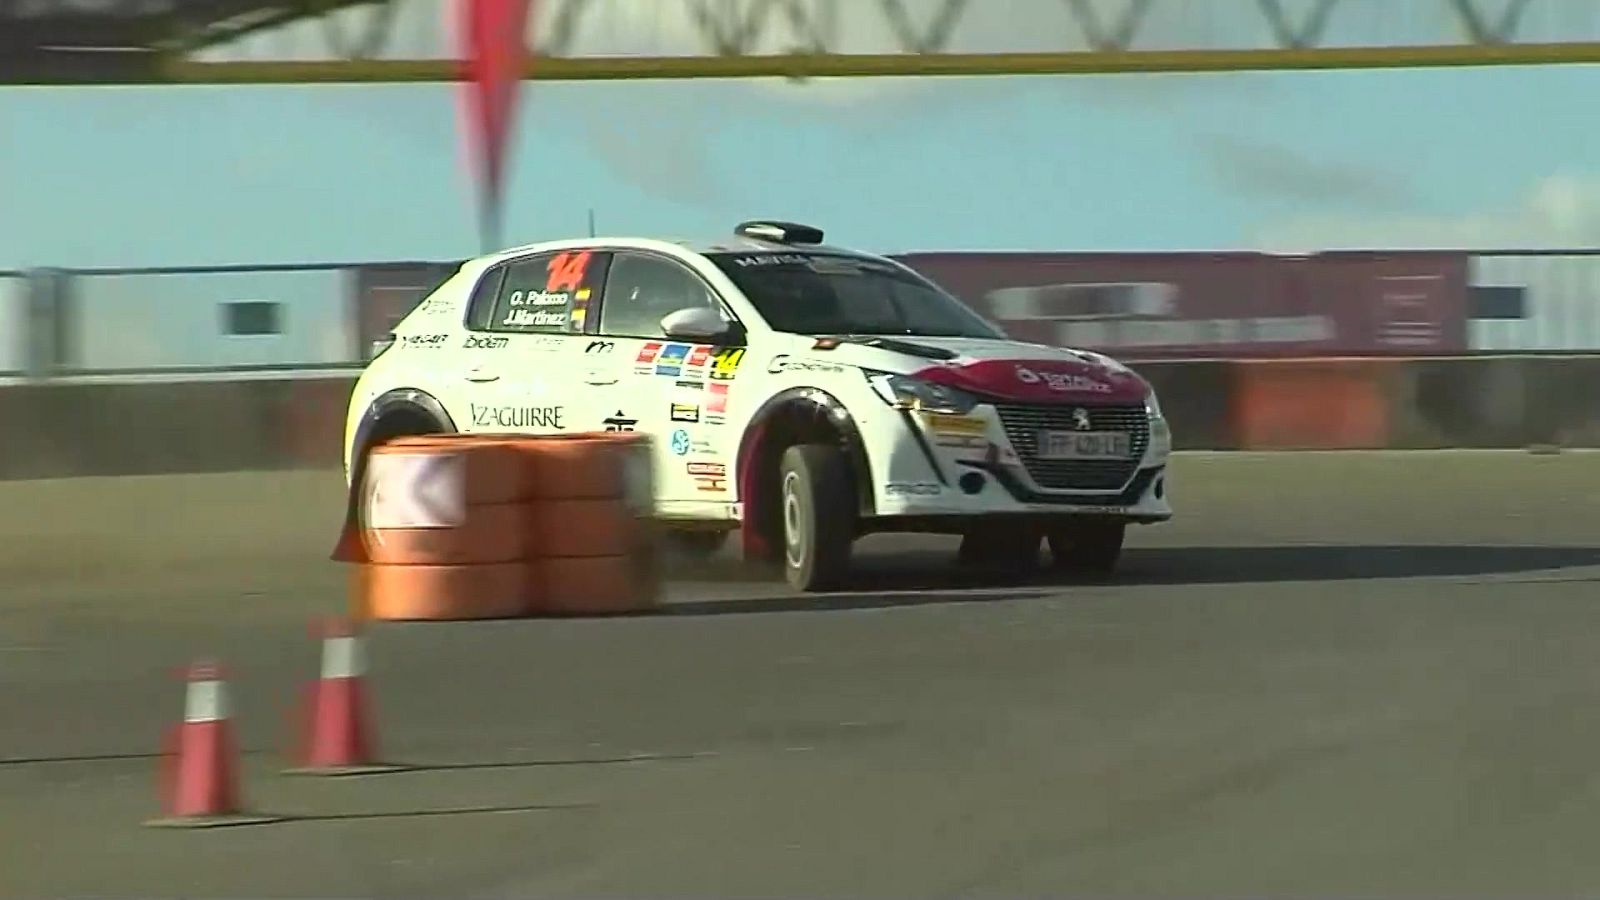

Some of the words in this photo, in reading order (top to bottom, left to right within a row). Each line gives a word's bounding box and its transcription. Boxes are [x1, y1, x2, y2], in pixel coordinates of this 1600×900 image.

[546, 251, 592, 292] 14
[510, 291, 524, 306] O.
[711, 347, 746, 368] 14
